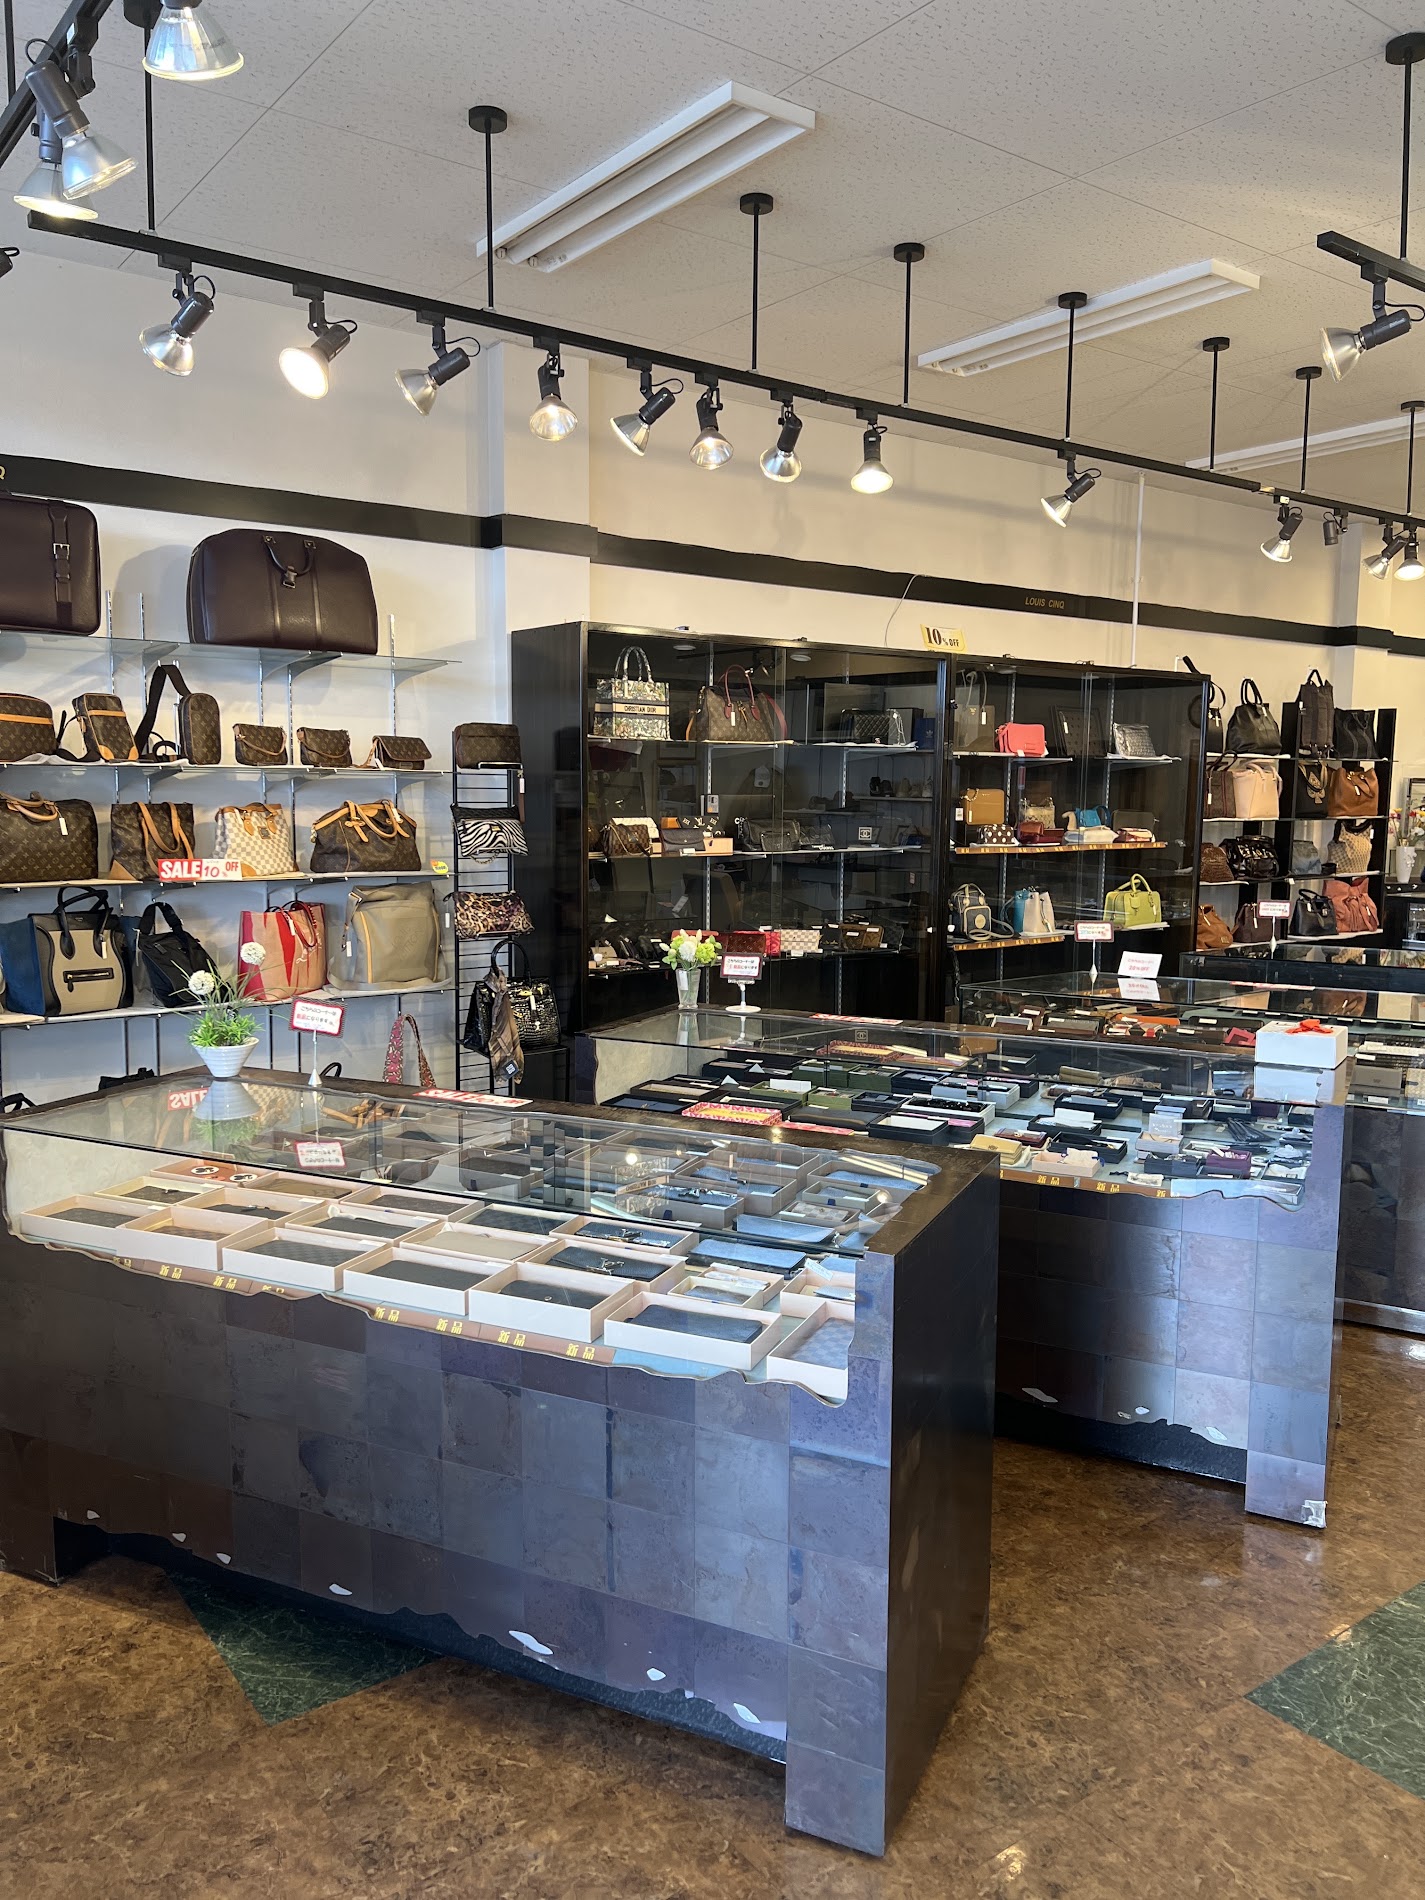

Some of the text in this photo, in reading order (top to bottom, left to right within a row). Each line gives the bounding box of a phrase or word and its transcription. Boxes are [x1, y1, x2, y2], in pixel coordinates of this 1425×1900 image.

[1025, 597, 1064, 609] LOUIS CINQ
[161, 861, 201, 879] SALE
[225, 861, 239, 872] OFF
[159, 1264, 183, 1280] 新品
[213, 1275, 237, 1290] 新品
[374, 1306, 400, 1323] 新品
[435, 1318, 463, 1335] 新品
[498, 1330, 526, 1347] 新品
[566, 1343, 595, 1361] 新品
